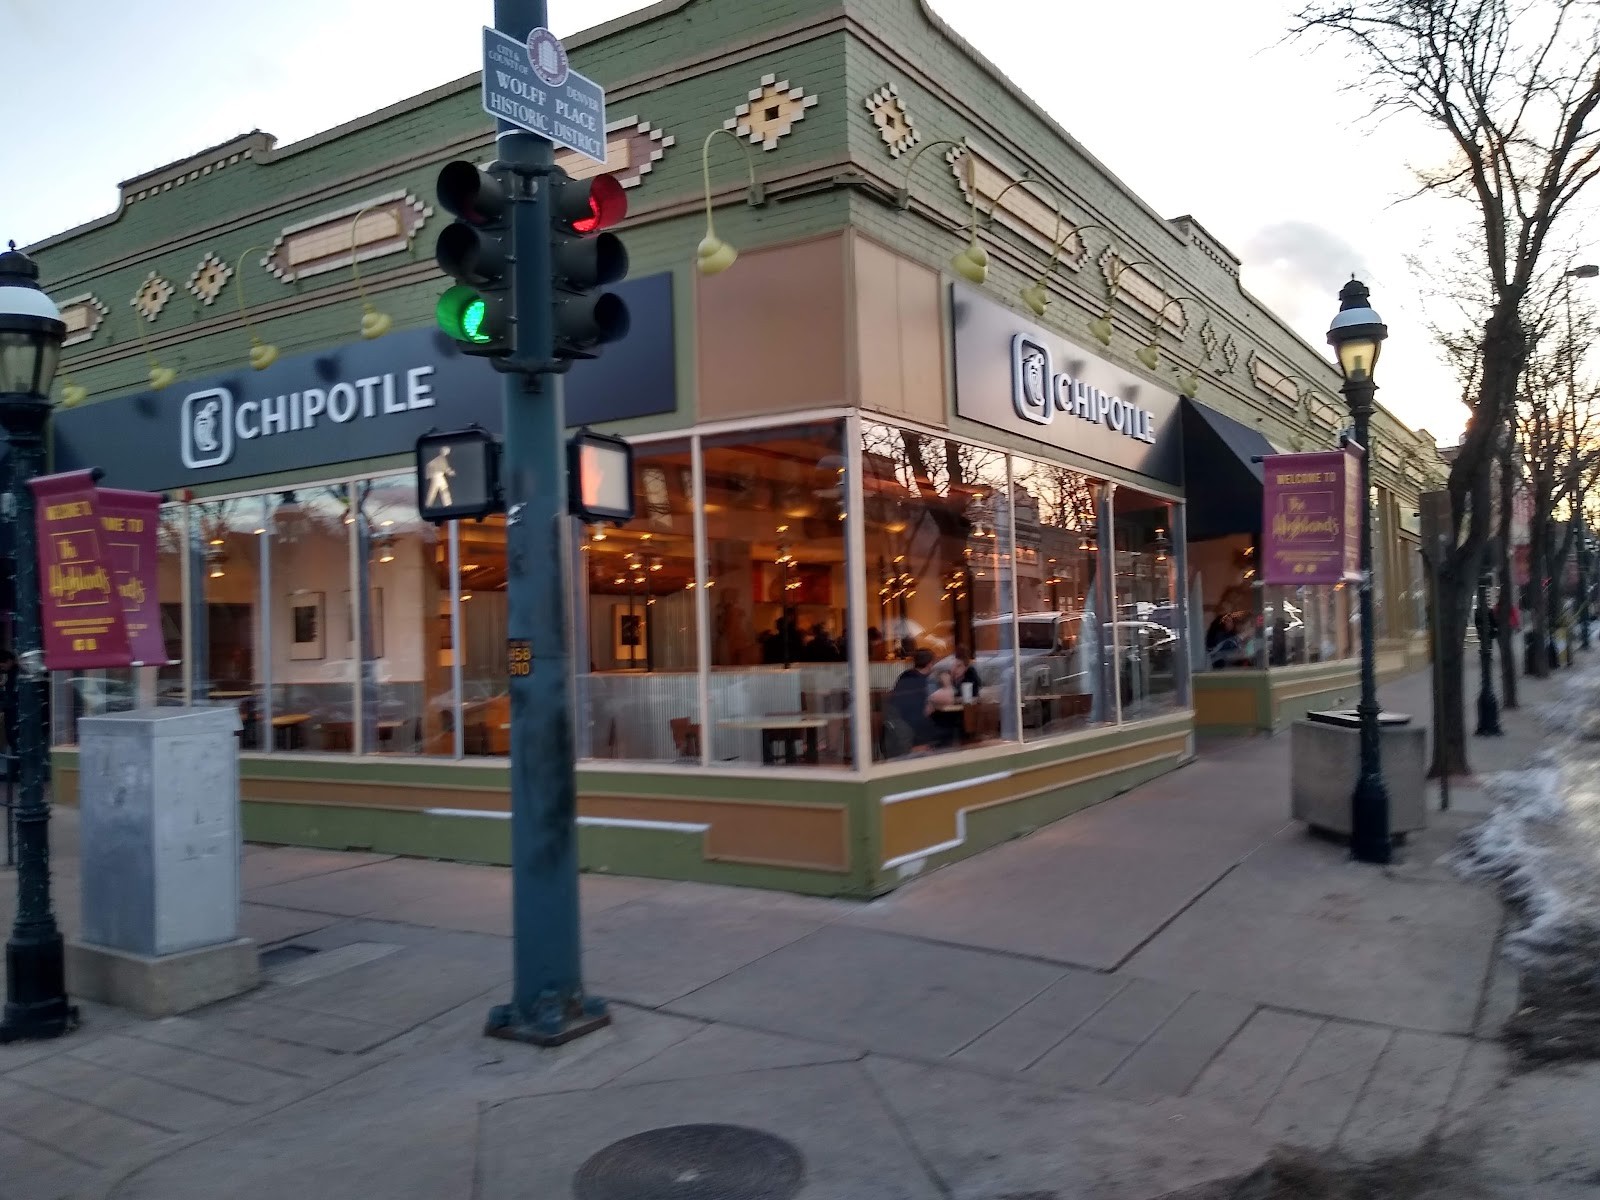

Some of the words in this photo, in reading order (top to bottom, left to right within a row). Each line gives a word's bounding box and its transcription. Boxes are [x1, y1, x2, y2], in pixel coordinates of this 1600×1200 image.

[489, 92, 549, 131] HISTORIC
[554, 121, 601, 156] DISTRICT
[496, 70, 547, 106] WOLFF
[555, 98, 597, 132] PLACE
[566, 85, 600, 112] DENVER
[235, 365, 436, 439] CHIPOTLE
[1054, 373, 1156, 444] CHIPOTLE
[1277, 473, 1321, 485] WELCOME
[1323, 472, 1336, 482] TO
